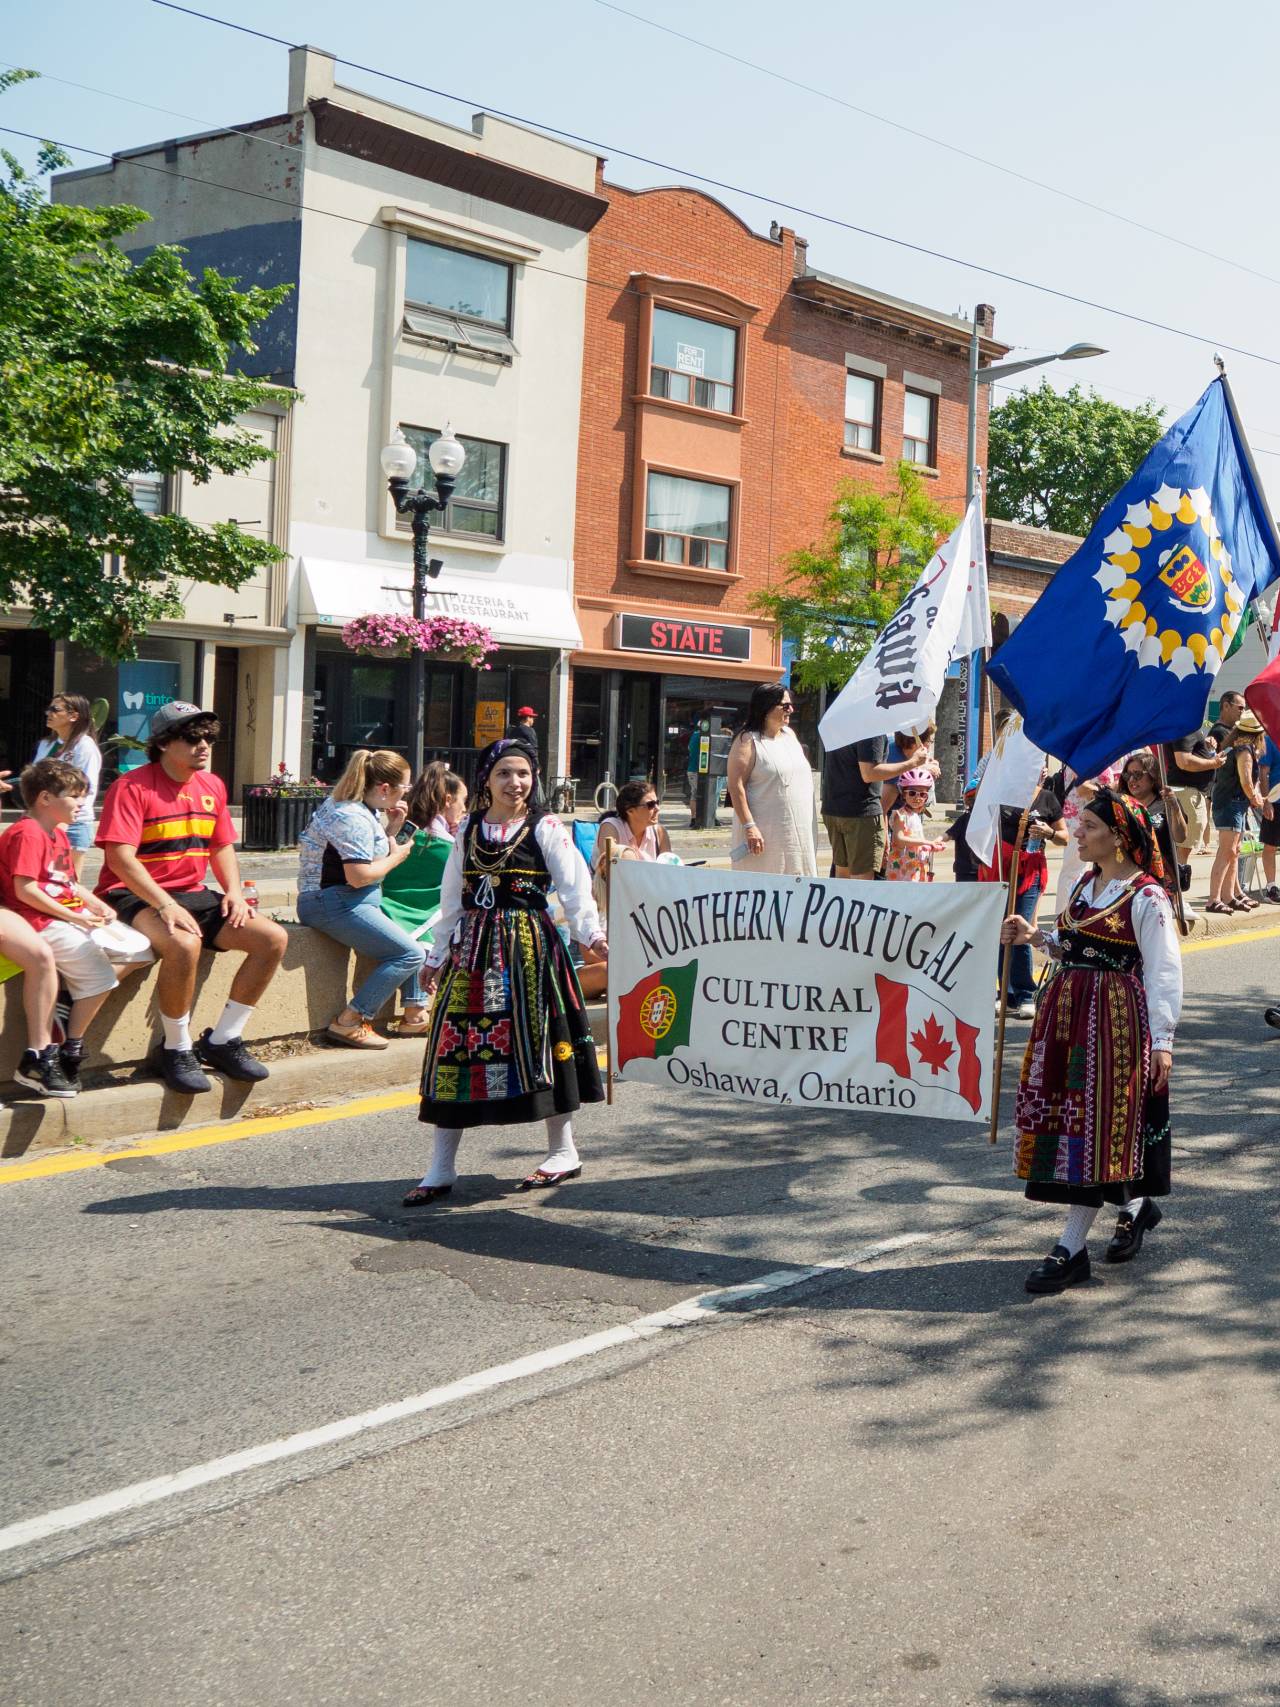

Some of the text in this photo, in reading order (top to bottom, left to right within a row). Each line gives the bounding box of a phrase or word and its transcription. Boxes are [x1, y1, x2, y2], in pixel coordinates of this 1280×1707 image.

[678, 352, 703, 368] RENT
[684, 346, 698, 356] FOR
[450, 593, 505, 608] PIZZERIA
[453, 604, 530, 621] RESTAURANT
[650, 621, 724, 653] STATE
[958, 700, 967, 732] ITALIA
[629, 883, 974, 992] NORTHERN PORTUGAL
[702, 976, 873, 1013] CULTURAL
[721, 1019, 849, 1053] CENTRE
[666, 1057, 916, 1109] Oshawa, Ontario
